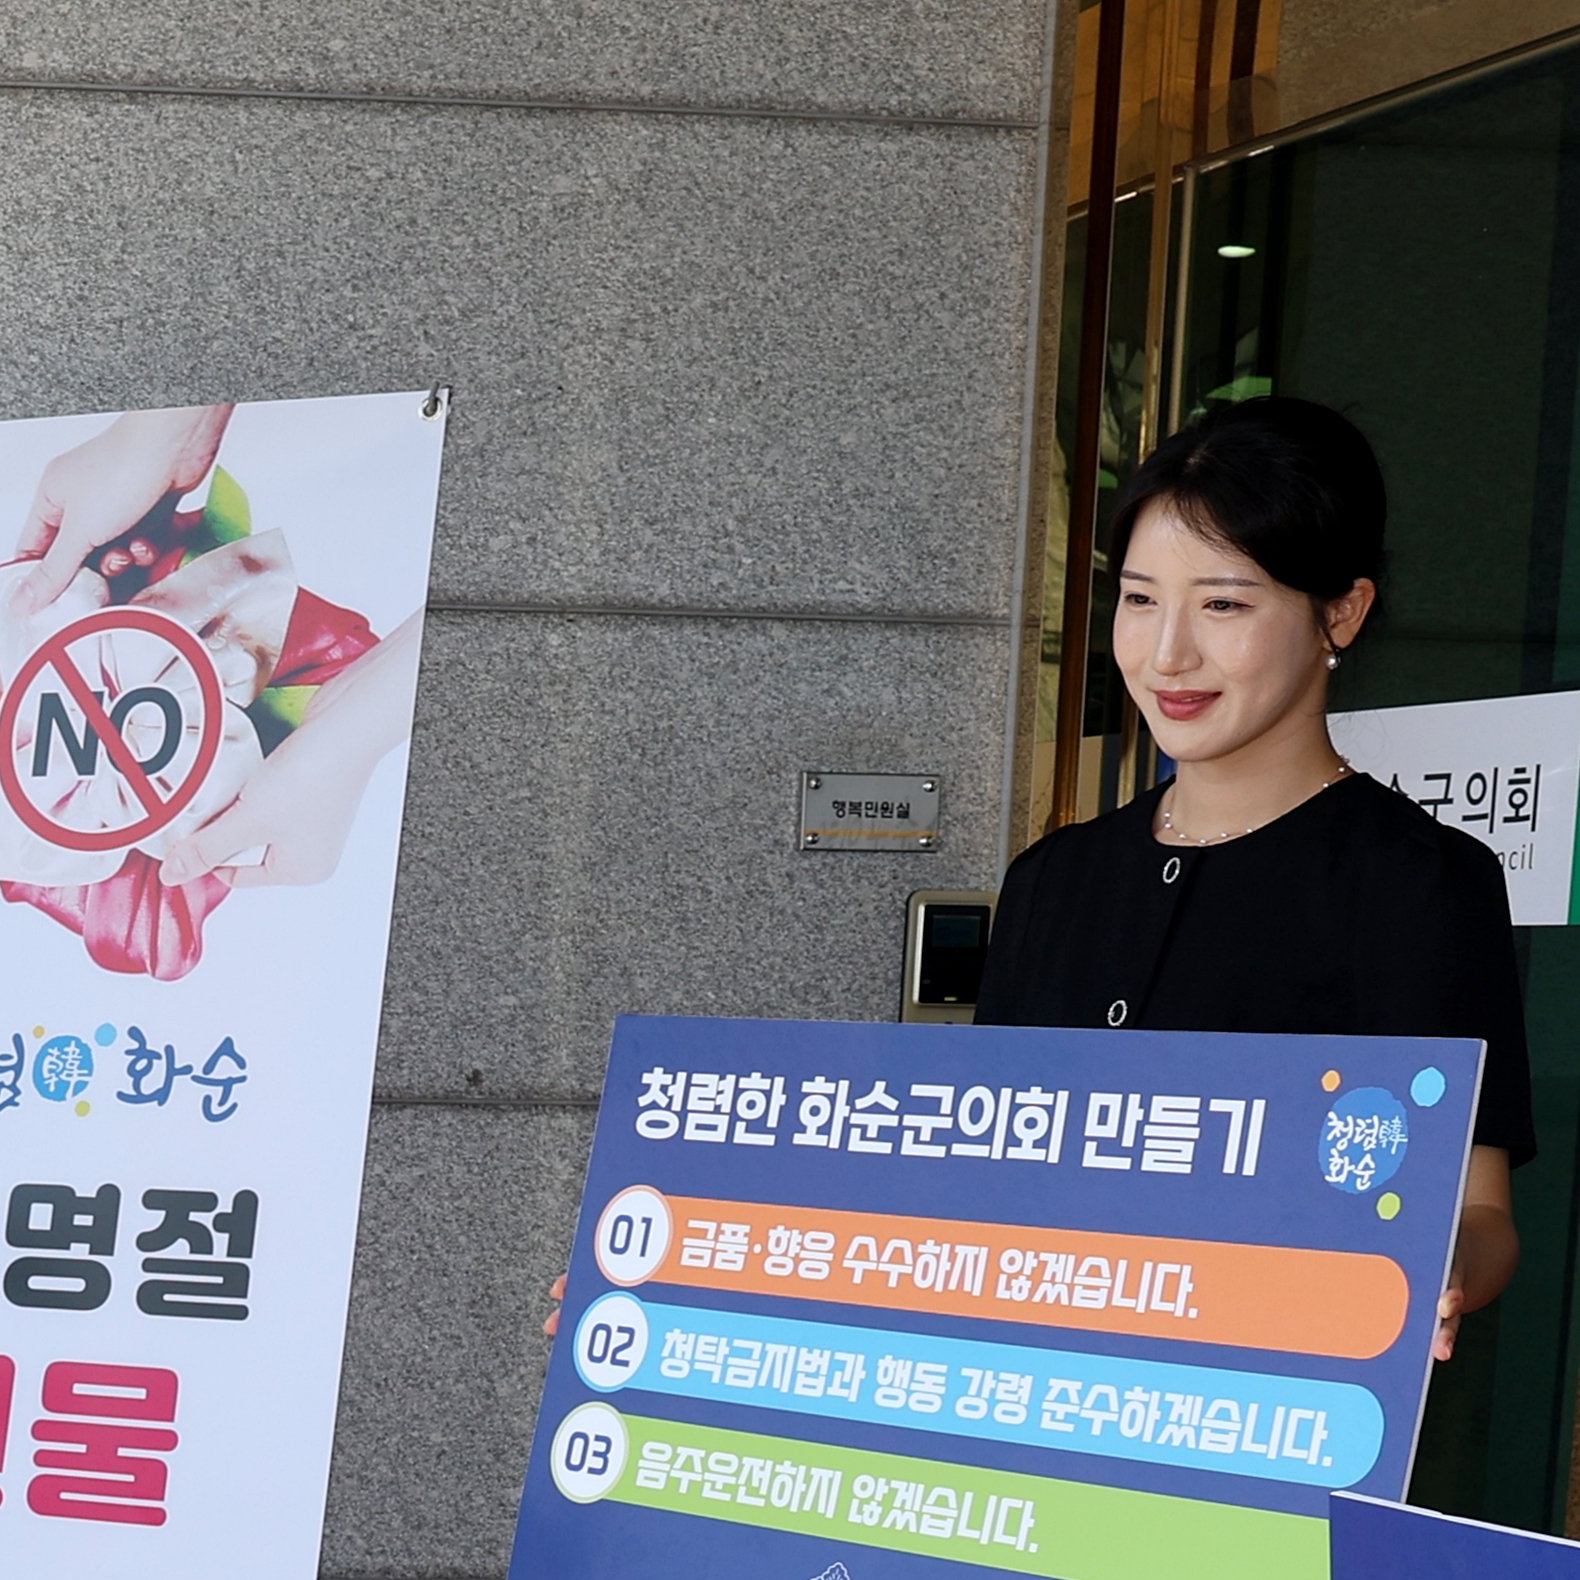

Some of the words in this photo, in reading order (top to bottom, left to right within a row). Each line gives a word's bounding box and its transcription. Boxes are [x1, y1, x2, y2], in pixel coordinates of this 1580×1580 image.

[31, 687, 183, 778] NO
[831, 800, 911, 820] 행복민원실
[116, 1025, 249, 1122] 화순
[634, 1066, 787, 1147] 청렴한
[792, 1075, 1070, 1164] 화순군의회
[1081, 1088, 1267, 1177] 만들기
[1324, 1149, 1377, 1191] 화순
[2, 1182, 260, 1321] 명절
[608, 1213, 653, 1259] 01
[841, 1234, 990, 1296] 수수하지
[995, 1247, 1199, 1319] 않겠습니다.
[586, 1321, 637, 1368] 02
[659, 1327, 867, 1402] 청탁금지법과
[873, 1354, 949, 1415] 행동
[953, 1367, 1035, 1427] 강령
[1038, 1376, 1335, 1468] 준수하겠습니다.
[563, 1430, 614, 1478] 03
[634, 1441, 843, 1520] 음주운전하지
[847, 1474, 1040, 1554] 않겠습니다.
